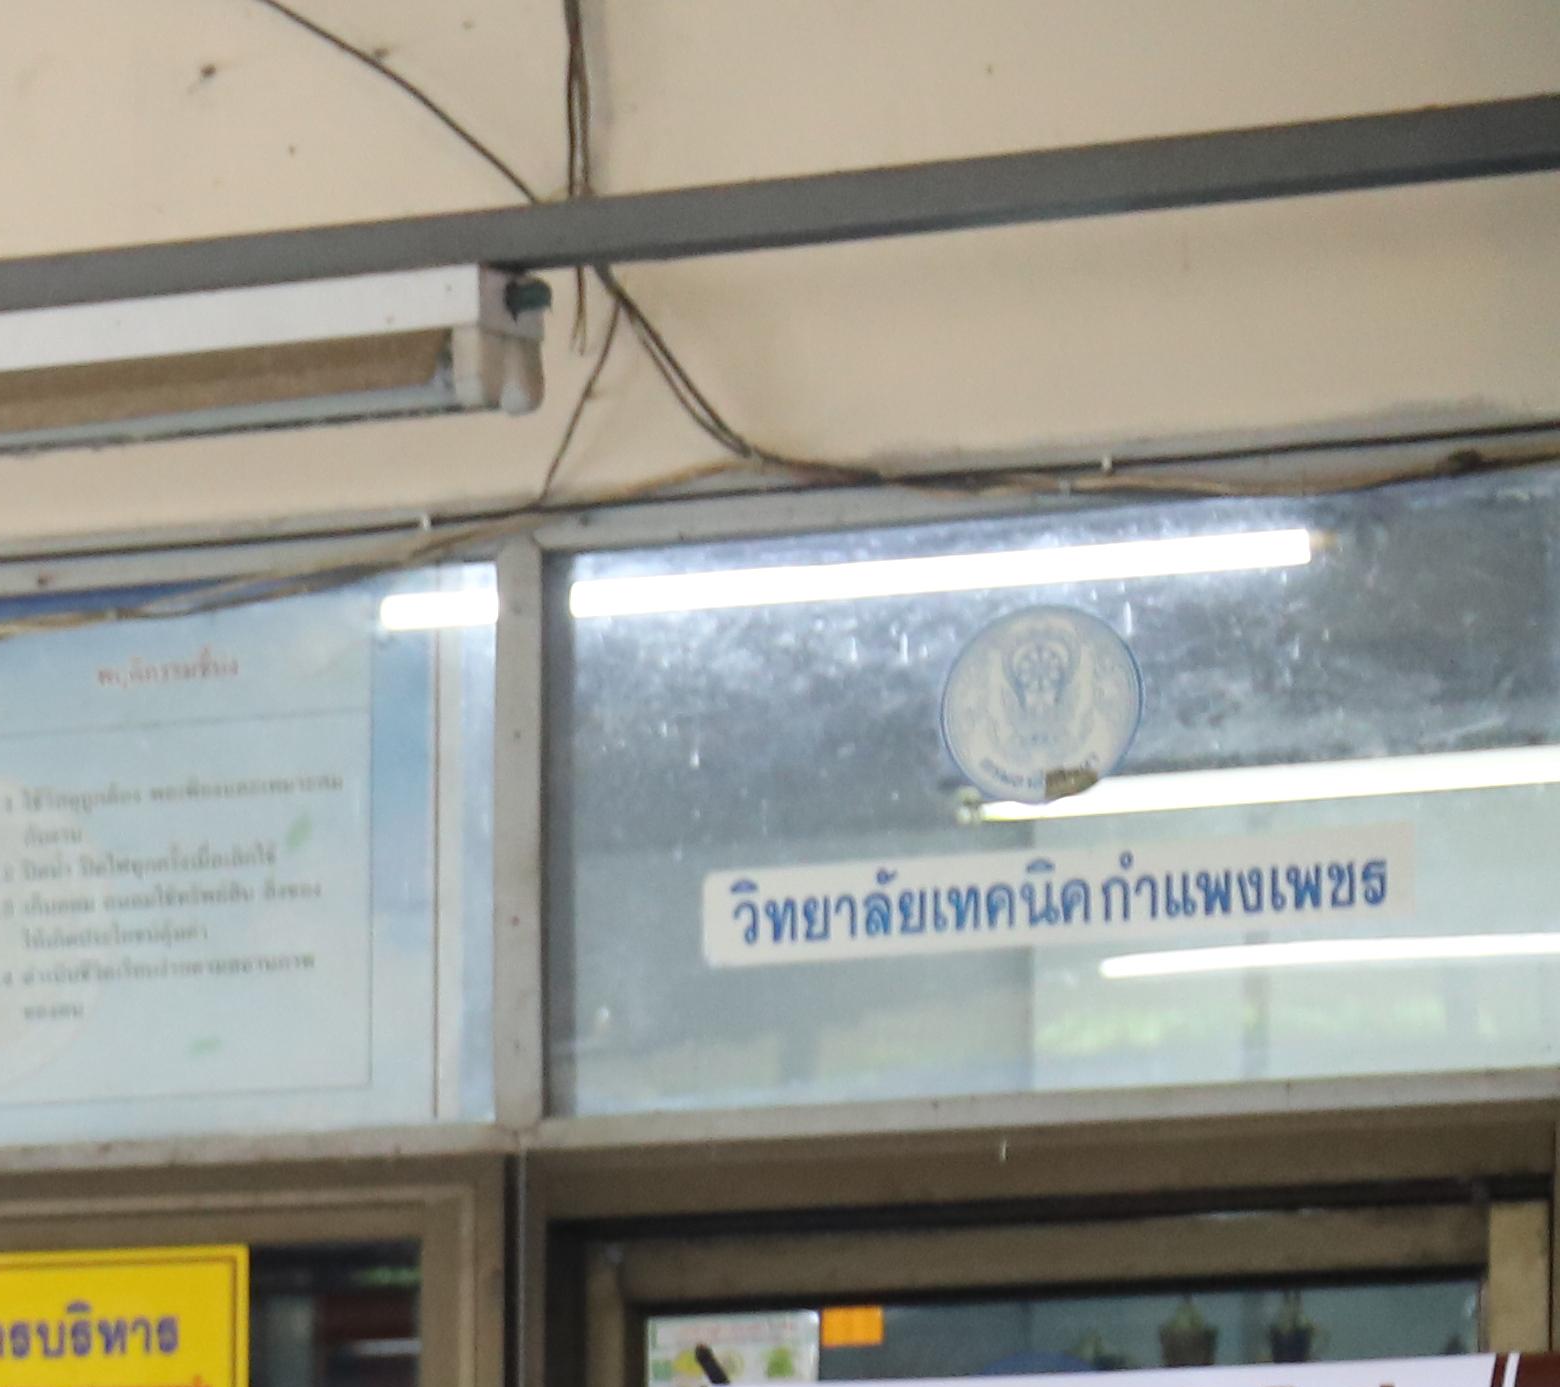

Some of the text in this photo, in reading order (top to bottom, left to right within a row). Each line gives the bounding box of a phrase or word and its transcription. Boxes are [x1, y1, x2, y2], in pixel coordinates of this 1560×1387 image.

[731, 851, 1388, 945] วิทยาลัยเทคนิคกำแพงเพชร
